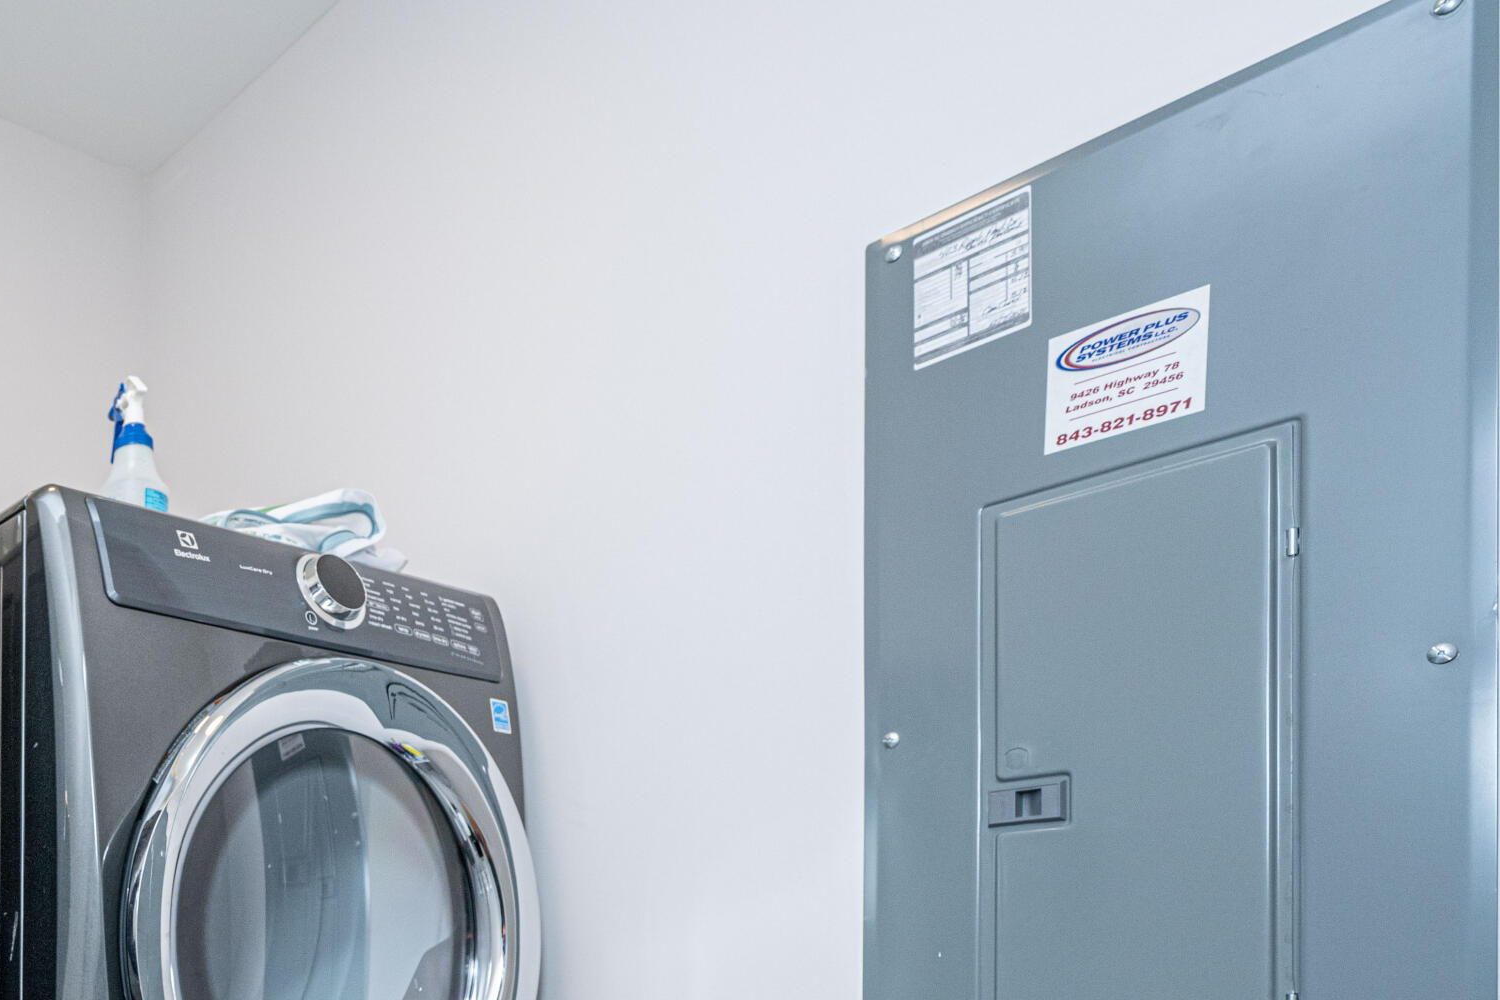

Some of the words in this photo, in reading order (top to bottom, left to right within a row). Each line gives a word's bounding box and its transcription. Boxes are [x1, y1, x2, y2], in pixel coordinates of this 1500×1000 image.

[1075, 331, 1154, 363] SYSTEMS
[1153, 326, 1179, 338] LLC.
[1080, 326, 1141, 354] POWER
[1142, 311, 1189, 333] PLUS
[1065, 396, 1113, 414] Ladson,
[1117, 386, 1135, 398] SC
[1142, 371, 1184, 390] 29456
[1070, 385, 1100, 401] 9426
[1104, 368, 1160, 392] Highway
[1164, 361, 1180, 373] 78
[1056, 396, 1193, 446] 843-821-8971
[173, 548, 212, 562] Electrolux
